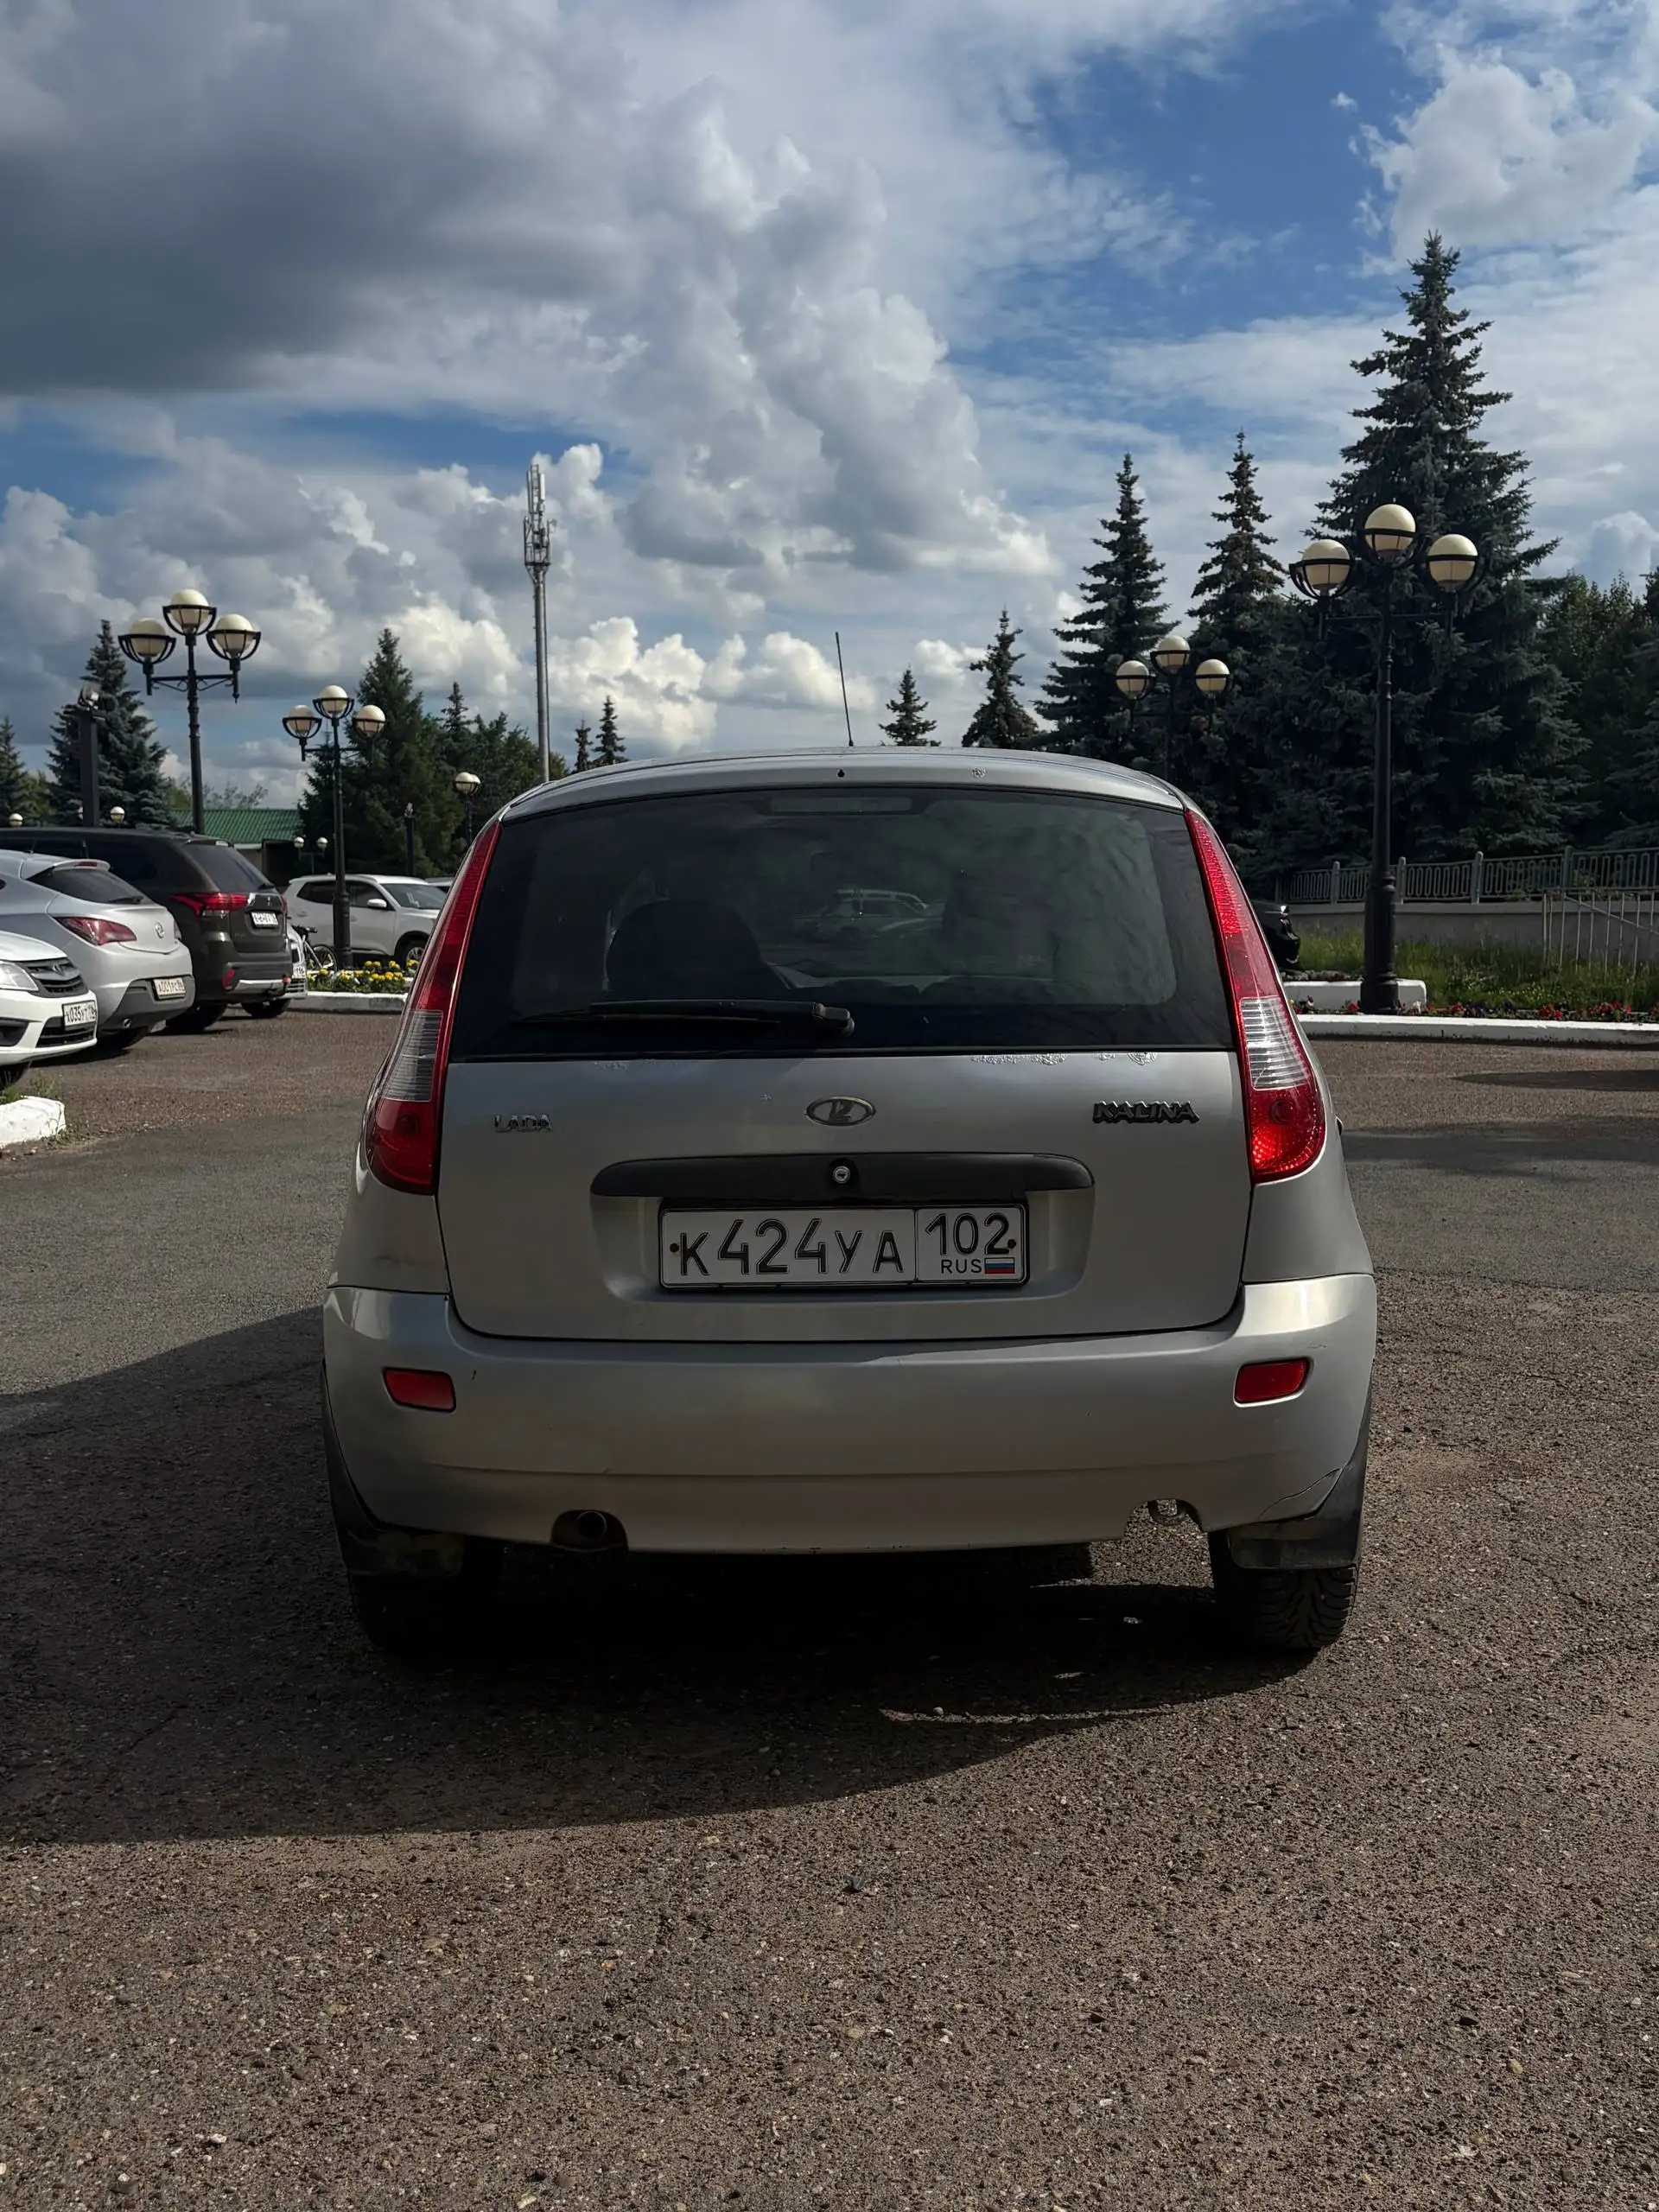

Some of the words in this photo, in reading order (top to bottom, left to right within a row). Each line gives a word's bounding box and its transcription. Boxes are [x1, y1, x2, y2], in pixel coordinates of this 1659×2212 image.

[494, 1113, 553, 1133] LADA
[1092, 1100, 1200, 1124] KALINA
[679, 1218, 904, 1275] К424УА
[925, 1212, 1010, 1255] 102
[941, 1259, 982, 1274] RUS
